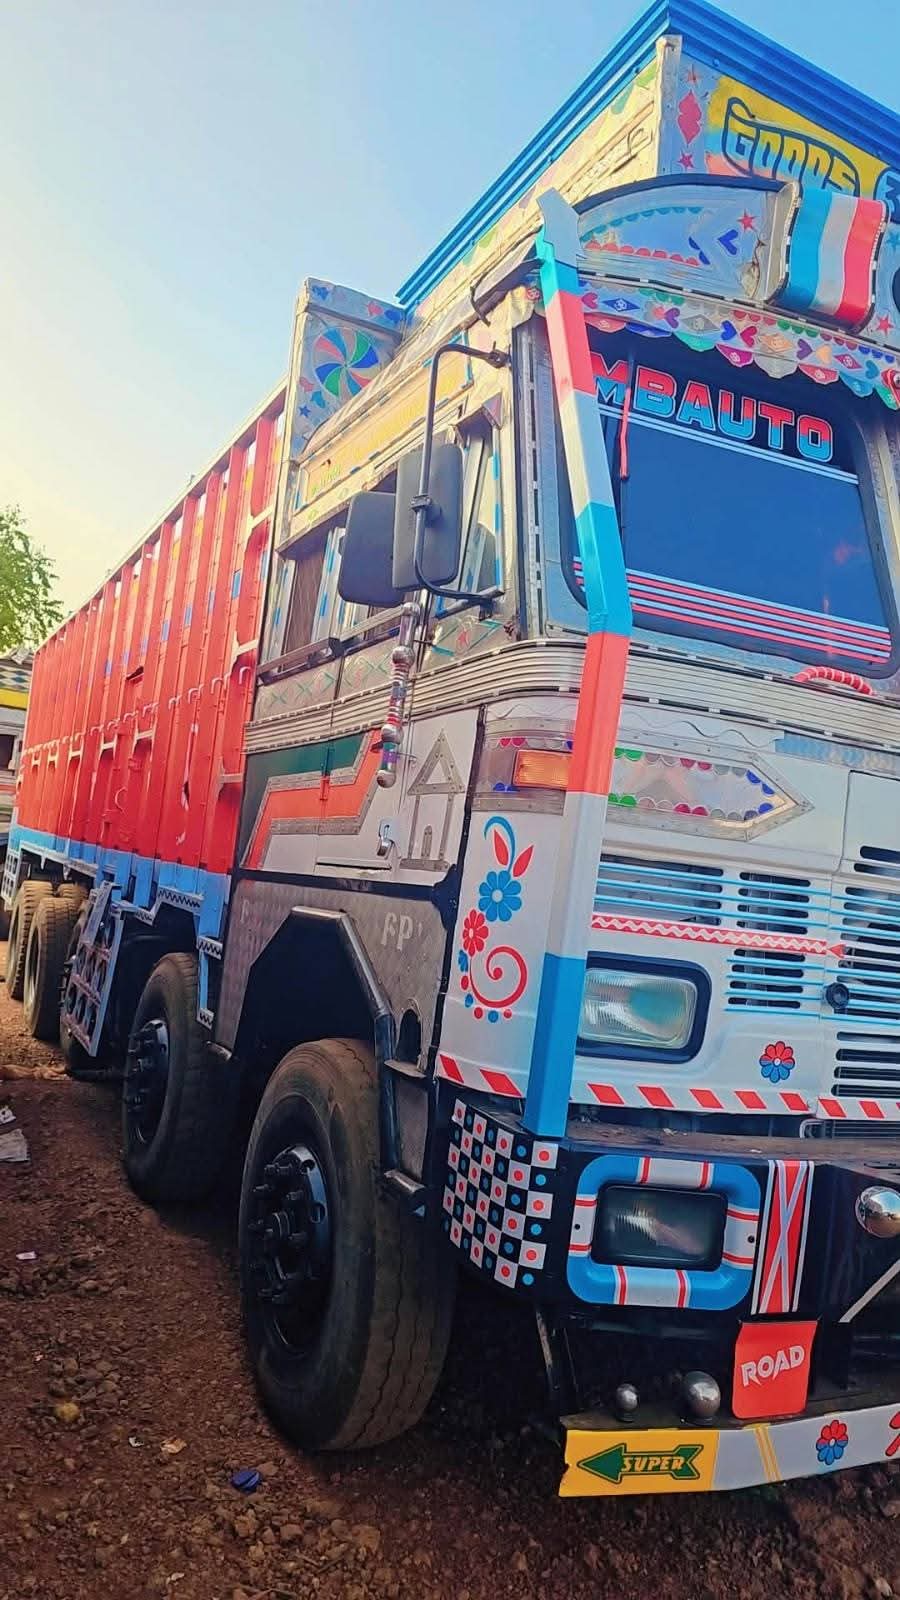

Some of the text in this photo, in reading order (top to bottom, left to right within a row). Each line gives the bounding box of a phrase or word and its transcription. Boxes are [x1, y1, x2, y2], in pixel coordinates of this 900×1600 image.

[722, 98, 860, 198] GOODS
[741, 1345, 805, 1388] ROAD
[621, 1456, 686, 1472] SUPER
